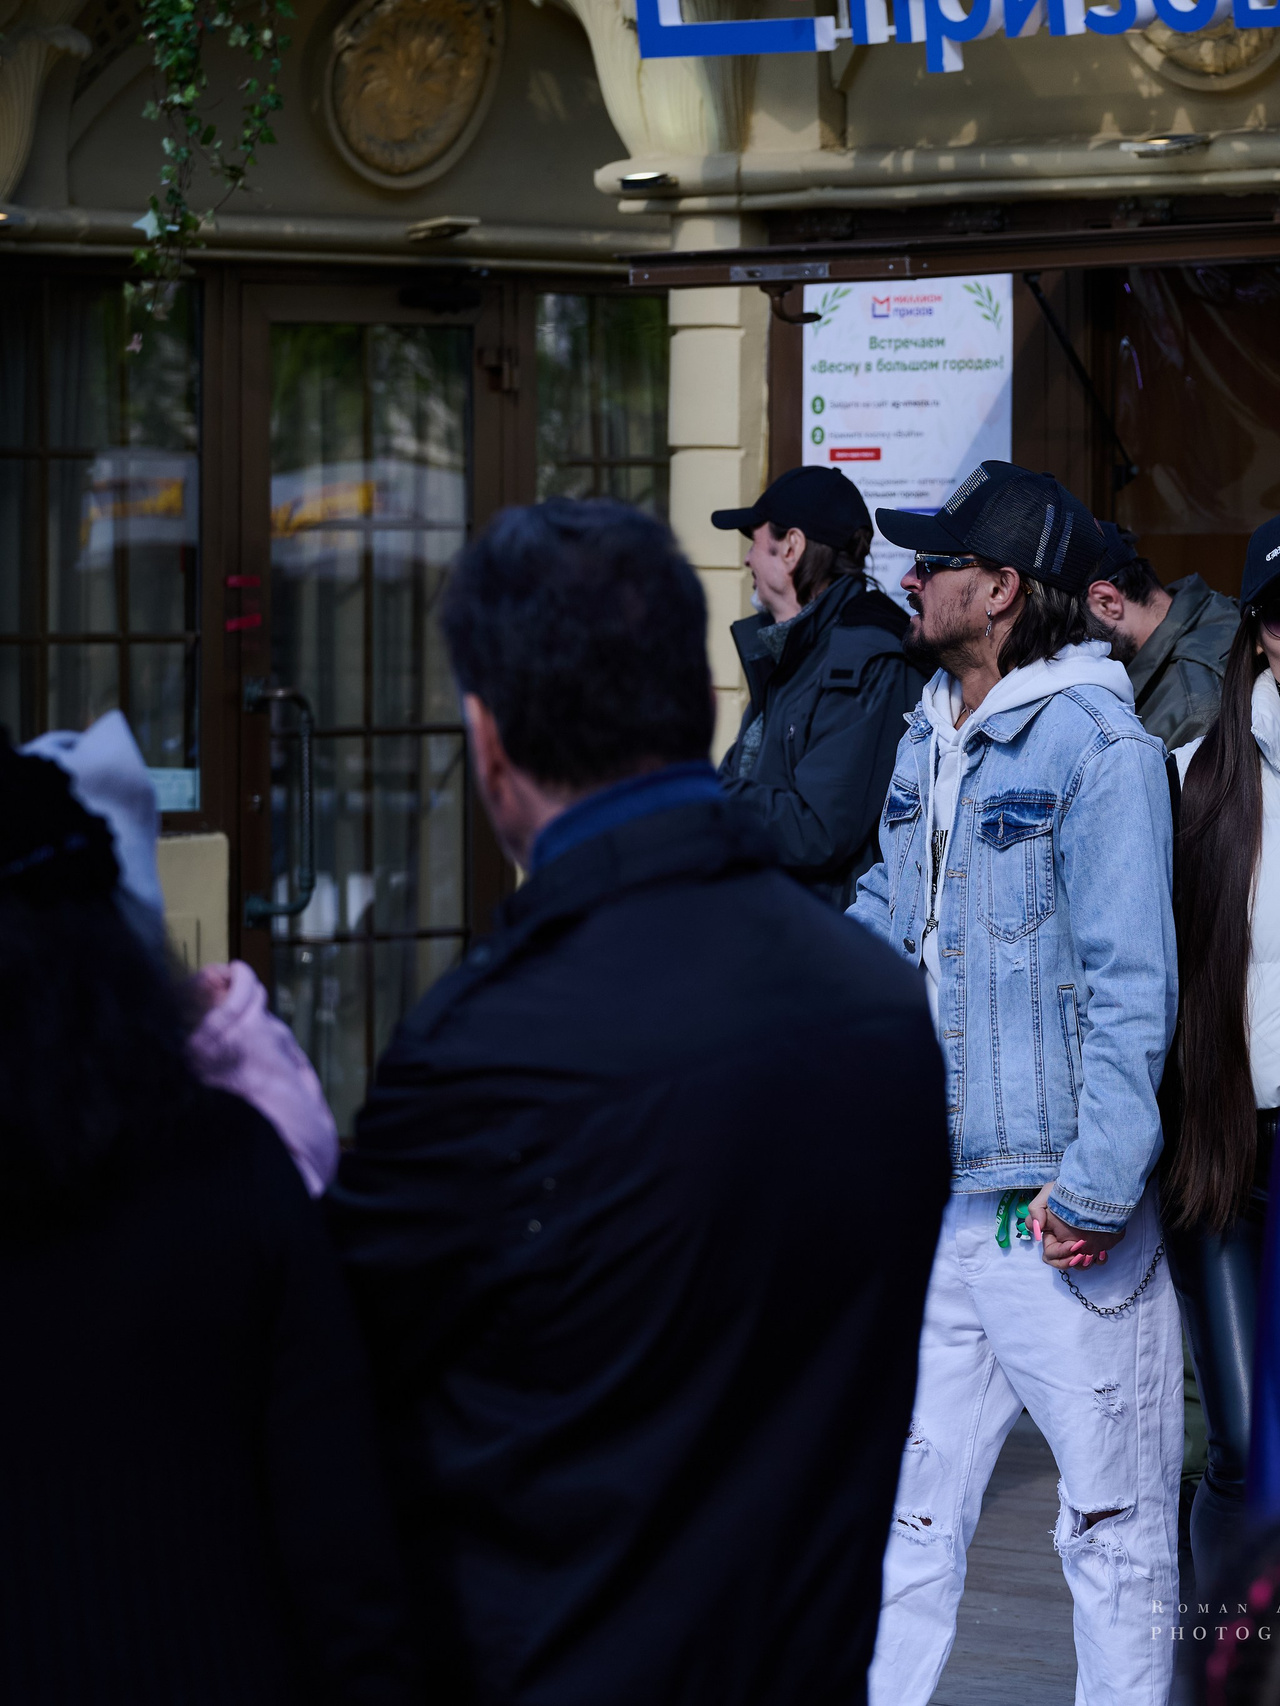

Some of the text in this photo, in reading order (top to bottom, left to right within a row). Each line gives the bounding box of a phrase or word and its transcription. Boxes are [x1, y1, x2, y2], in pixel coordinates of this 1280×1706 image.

[869, 335, 946, 351] Встречаем
[811, 360, 860, 376] «Весну
[864, 361, 872, 372] в
[876, 358, 939, 372] большом
